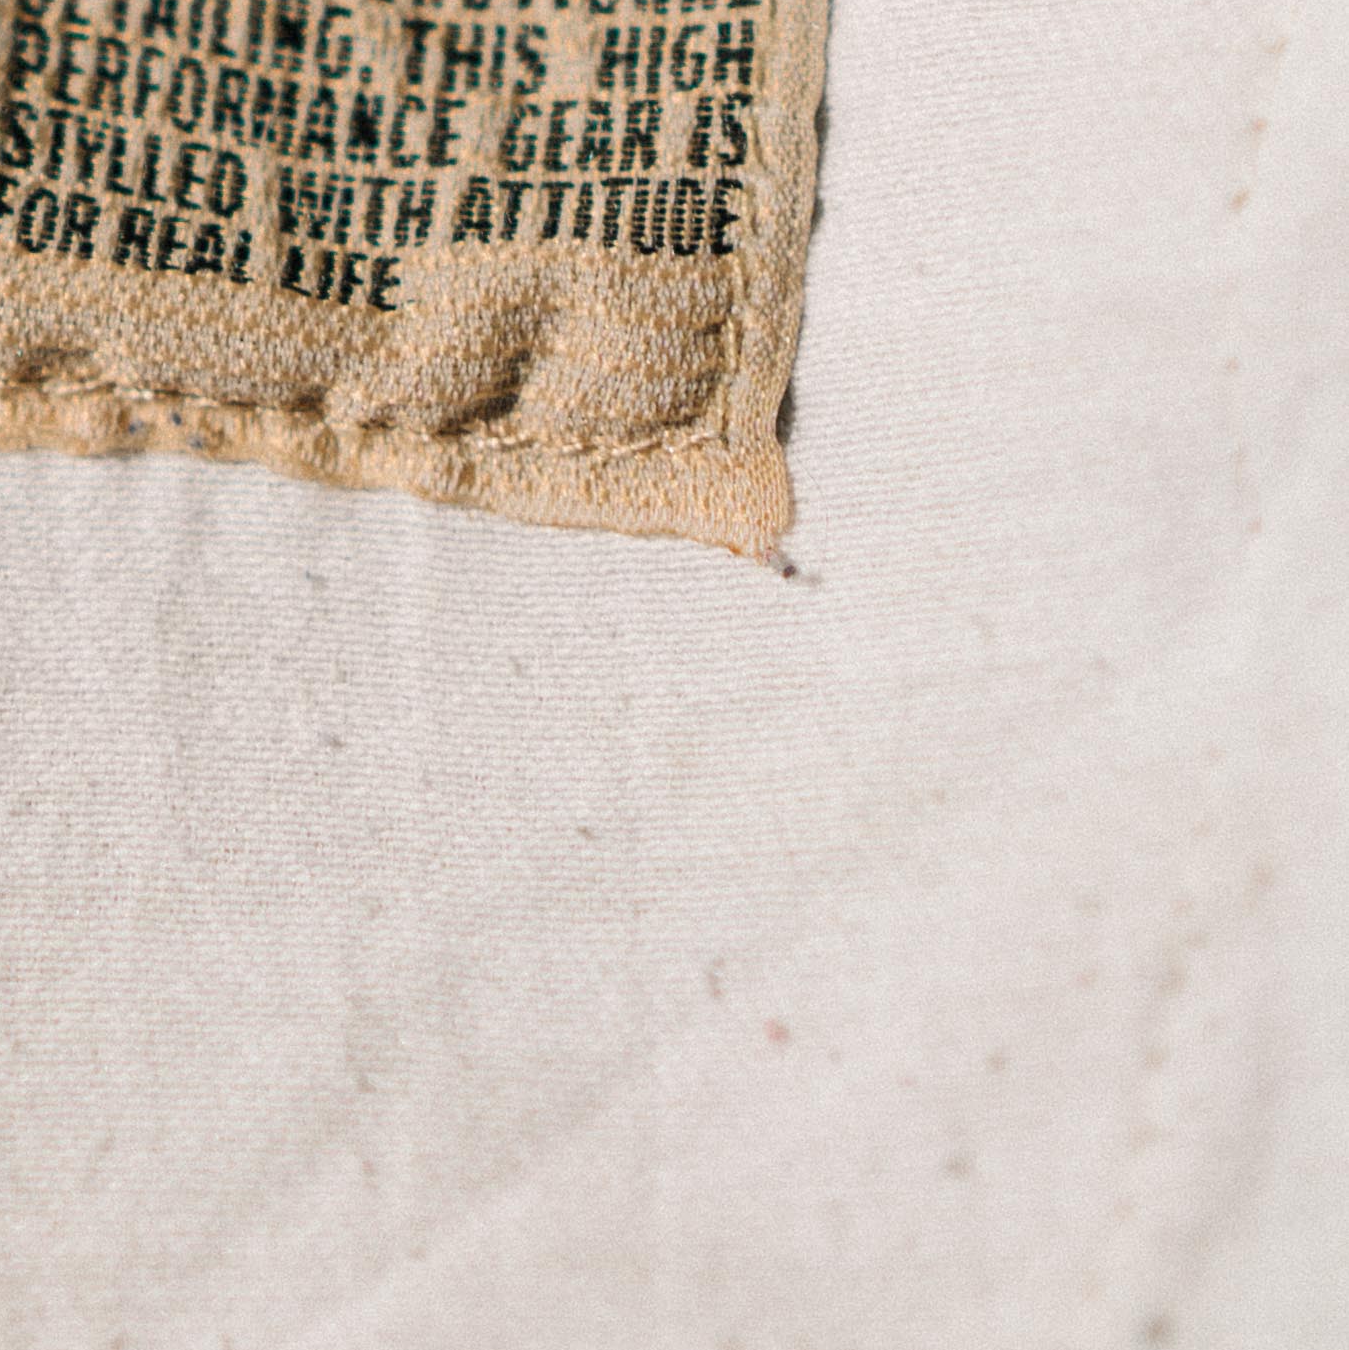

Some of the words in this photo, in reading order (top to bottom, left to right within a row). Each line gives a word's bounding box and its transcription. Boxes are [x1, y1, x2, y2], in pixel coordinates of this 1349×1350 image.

[9, 18, 467, 169] PERFORMANCE
[499, 99, 663, 173] GEAR
[686, 91, 754, 170] IS
[402, 18, 548, 95] THIS
[600, 18, 755, 94] HIGH
[112, 203, 253, 285] REAL
[280, 244, 402, 312] LIFE
[278, 165, 436, 248] WITH
[451, 175, 745, 256] ATTITUDE
